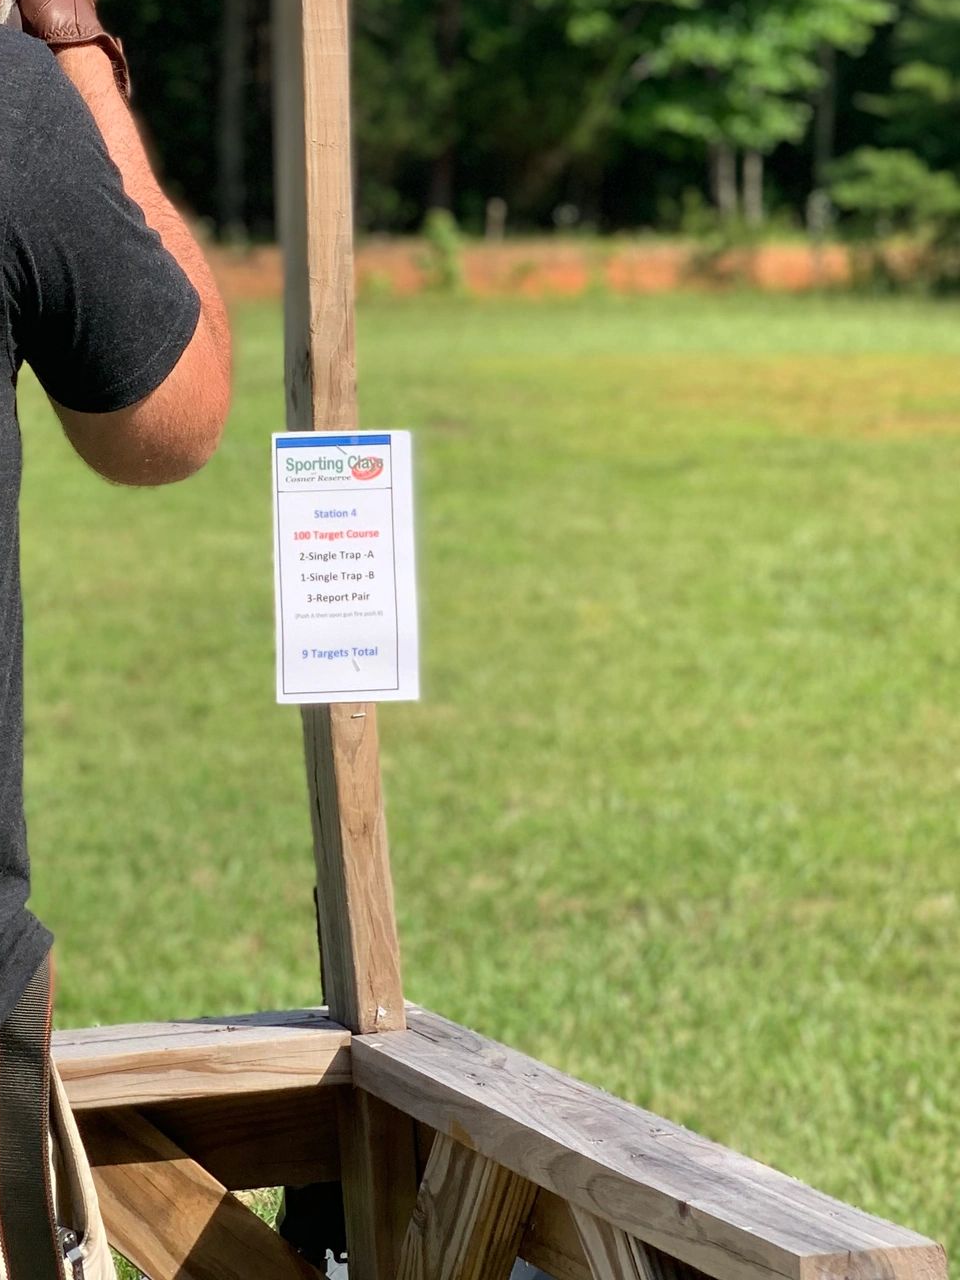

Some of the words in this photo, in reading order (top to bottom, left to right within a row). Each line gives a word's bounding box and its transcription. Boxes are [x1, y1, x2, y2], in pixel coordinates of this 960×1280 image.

[286, 456, 344, 474] Sporting
[348, 454, 384, 472] Clays
[314, 509, 348, 518] Station
[350, 508, 356, 516] 4
[294, 531, 311, 540] 100
[313, 530, 344, 540] Target
[346, 529, 380, 538] Course
[300, 552, 337, 562] 2-Single
[340, 551, 361, 560] Trap
[364, 550, 374, 558] -A
[301, 572, 338, 582] 1-Single
[341, 572, 362, 581] Trap
[365, 571, 374, 580] -B
[307, 594, 349, 604] 3-Report
[352, 592, 370, 601] Pair
[302, 649, 308, 659] 9
[312, 649, 349, 660] Targets
[352, 646, 378, 656] Total
